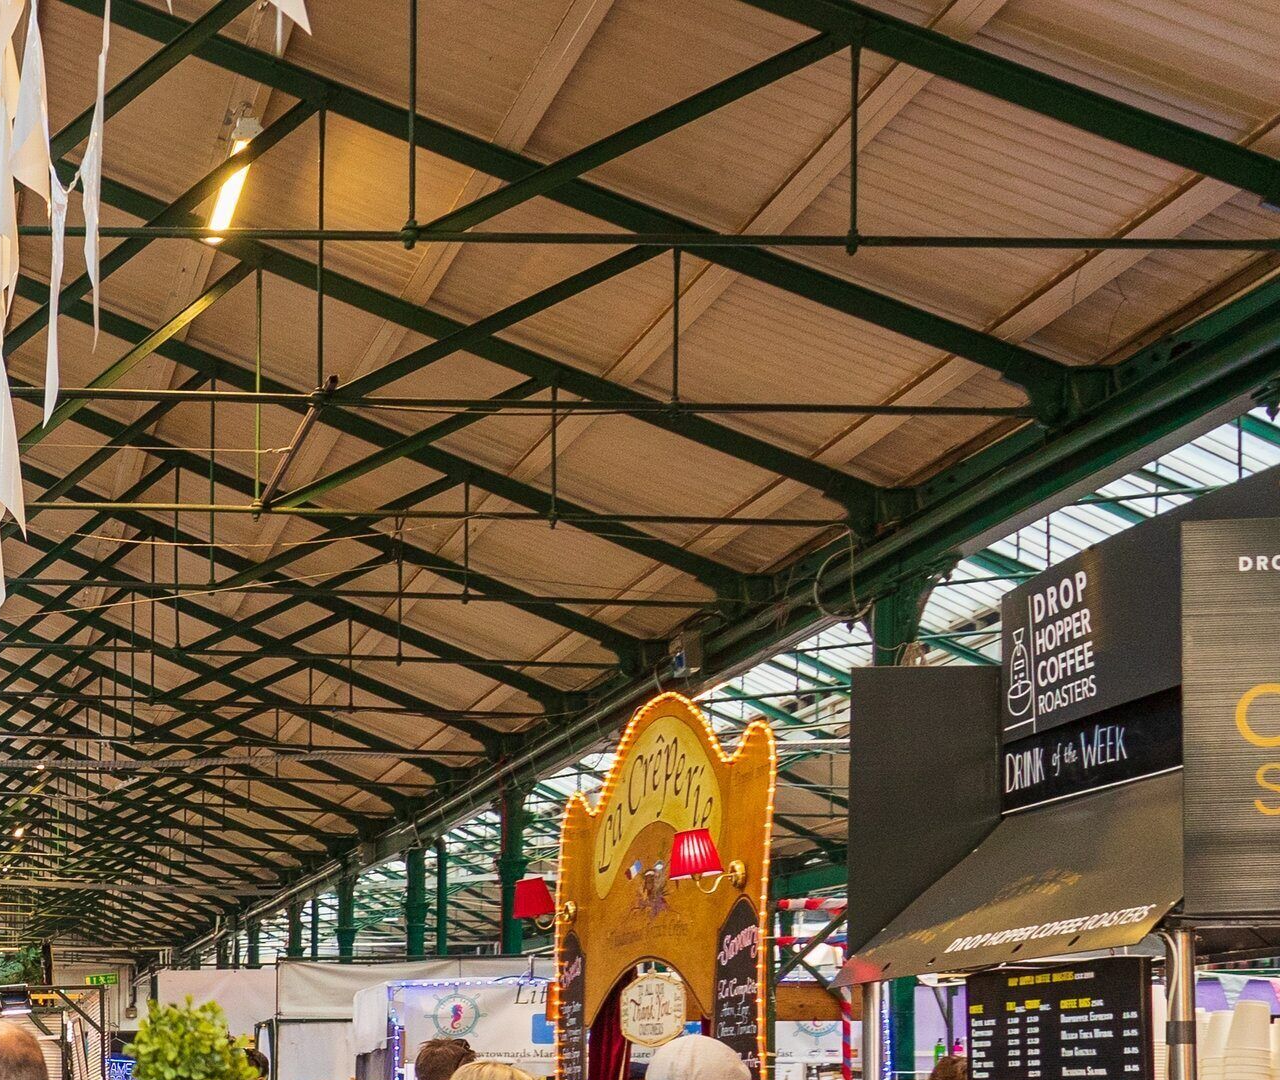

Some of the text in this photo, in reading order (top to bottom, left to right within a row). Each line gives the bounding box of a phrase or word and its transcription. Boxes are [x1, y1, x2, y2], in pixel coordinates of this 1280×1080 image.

[1032, 570, 1087, 624] DROP
[1035, 607, 1092, 656] HOPPER
[1037, 641, 1095, 688] COFFEE
[1038, 675, 1097, 716] ROASTERS
[1005, 724, 1128, 794] DRINK of the WEEK
[599, 803, 623, 874] La
[944, 903, 1157, 953] DROP HOPPER COFFEE ROASTERS
[111, 1062, 132, 1075] AME
